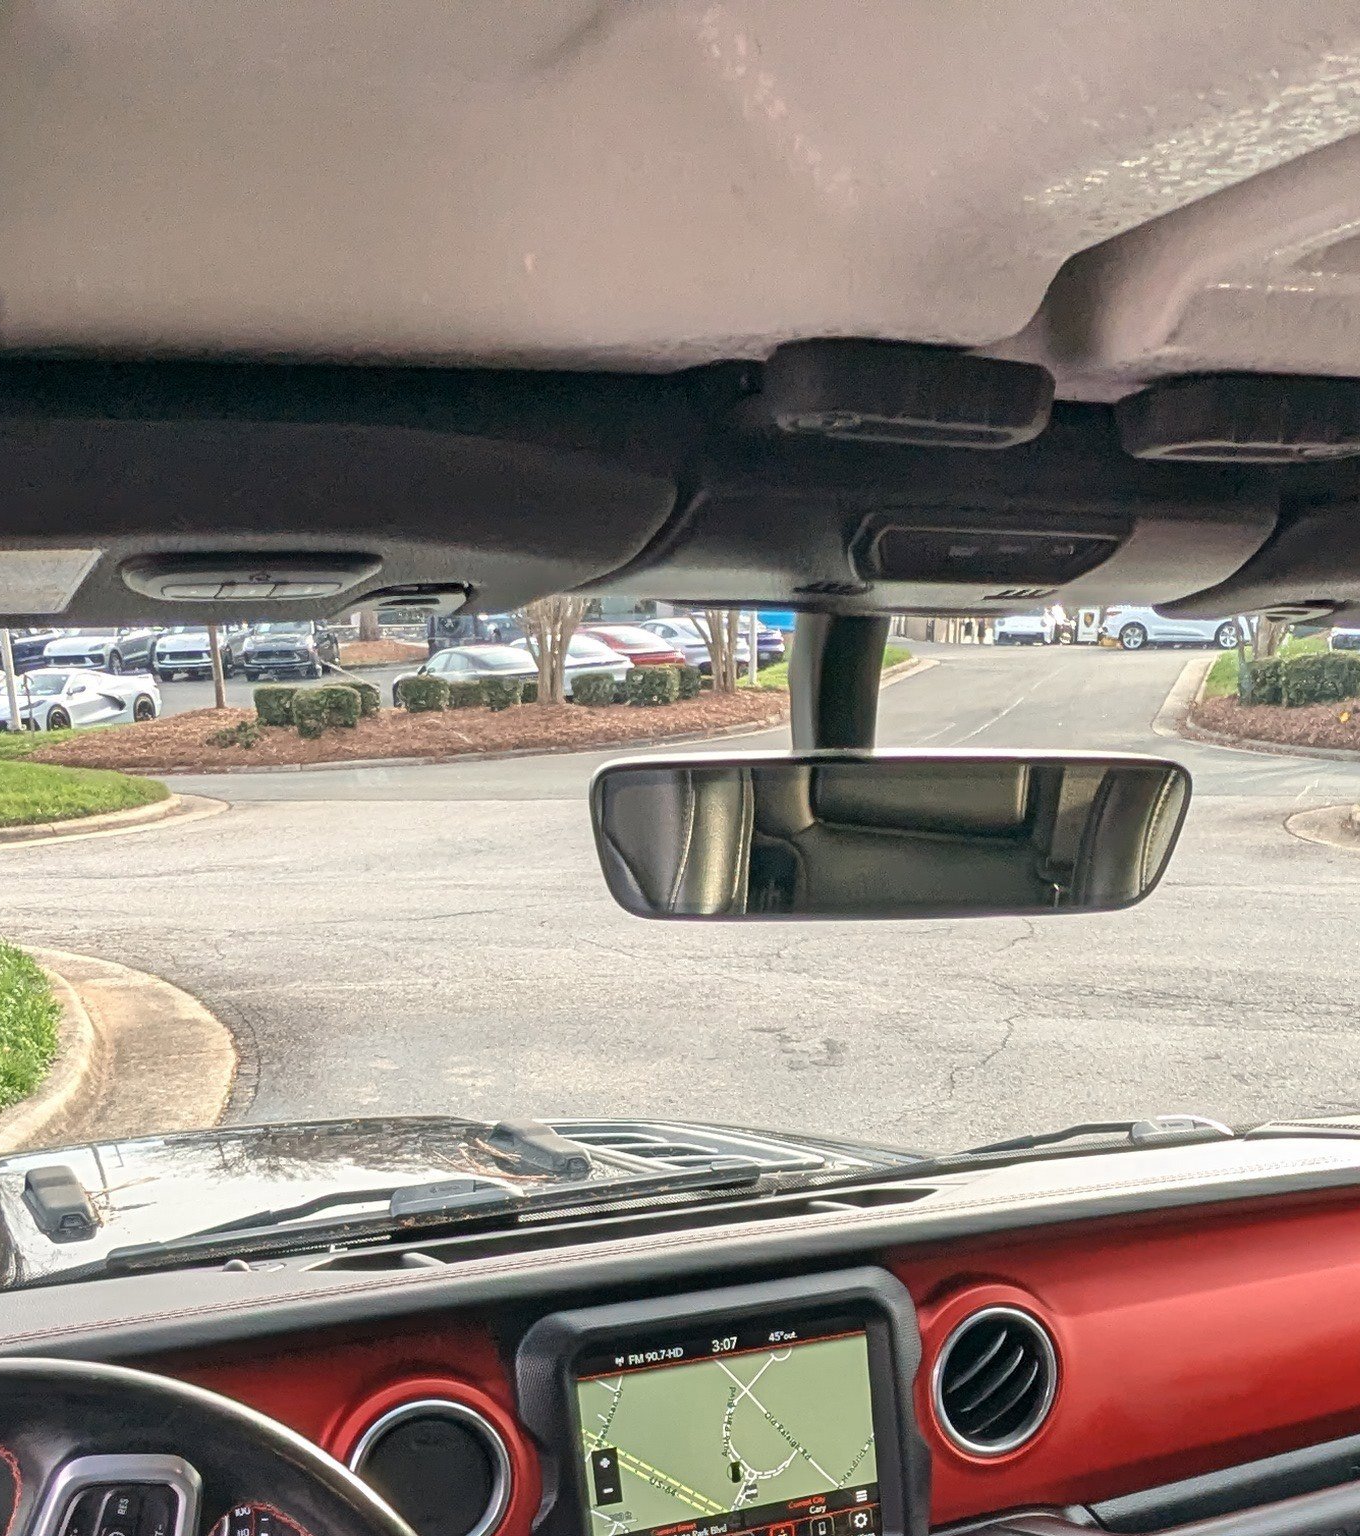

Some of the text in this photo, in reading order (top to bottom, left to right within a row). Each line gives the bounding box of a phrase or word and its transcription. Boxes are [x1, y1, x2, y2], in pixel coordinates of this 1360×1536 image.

[711, 1336, 738, 1352] 3:07
[628, 1354, 645, 1366] FM
[809, 1504, 827, 1515] Cary
